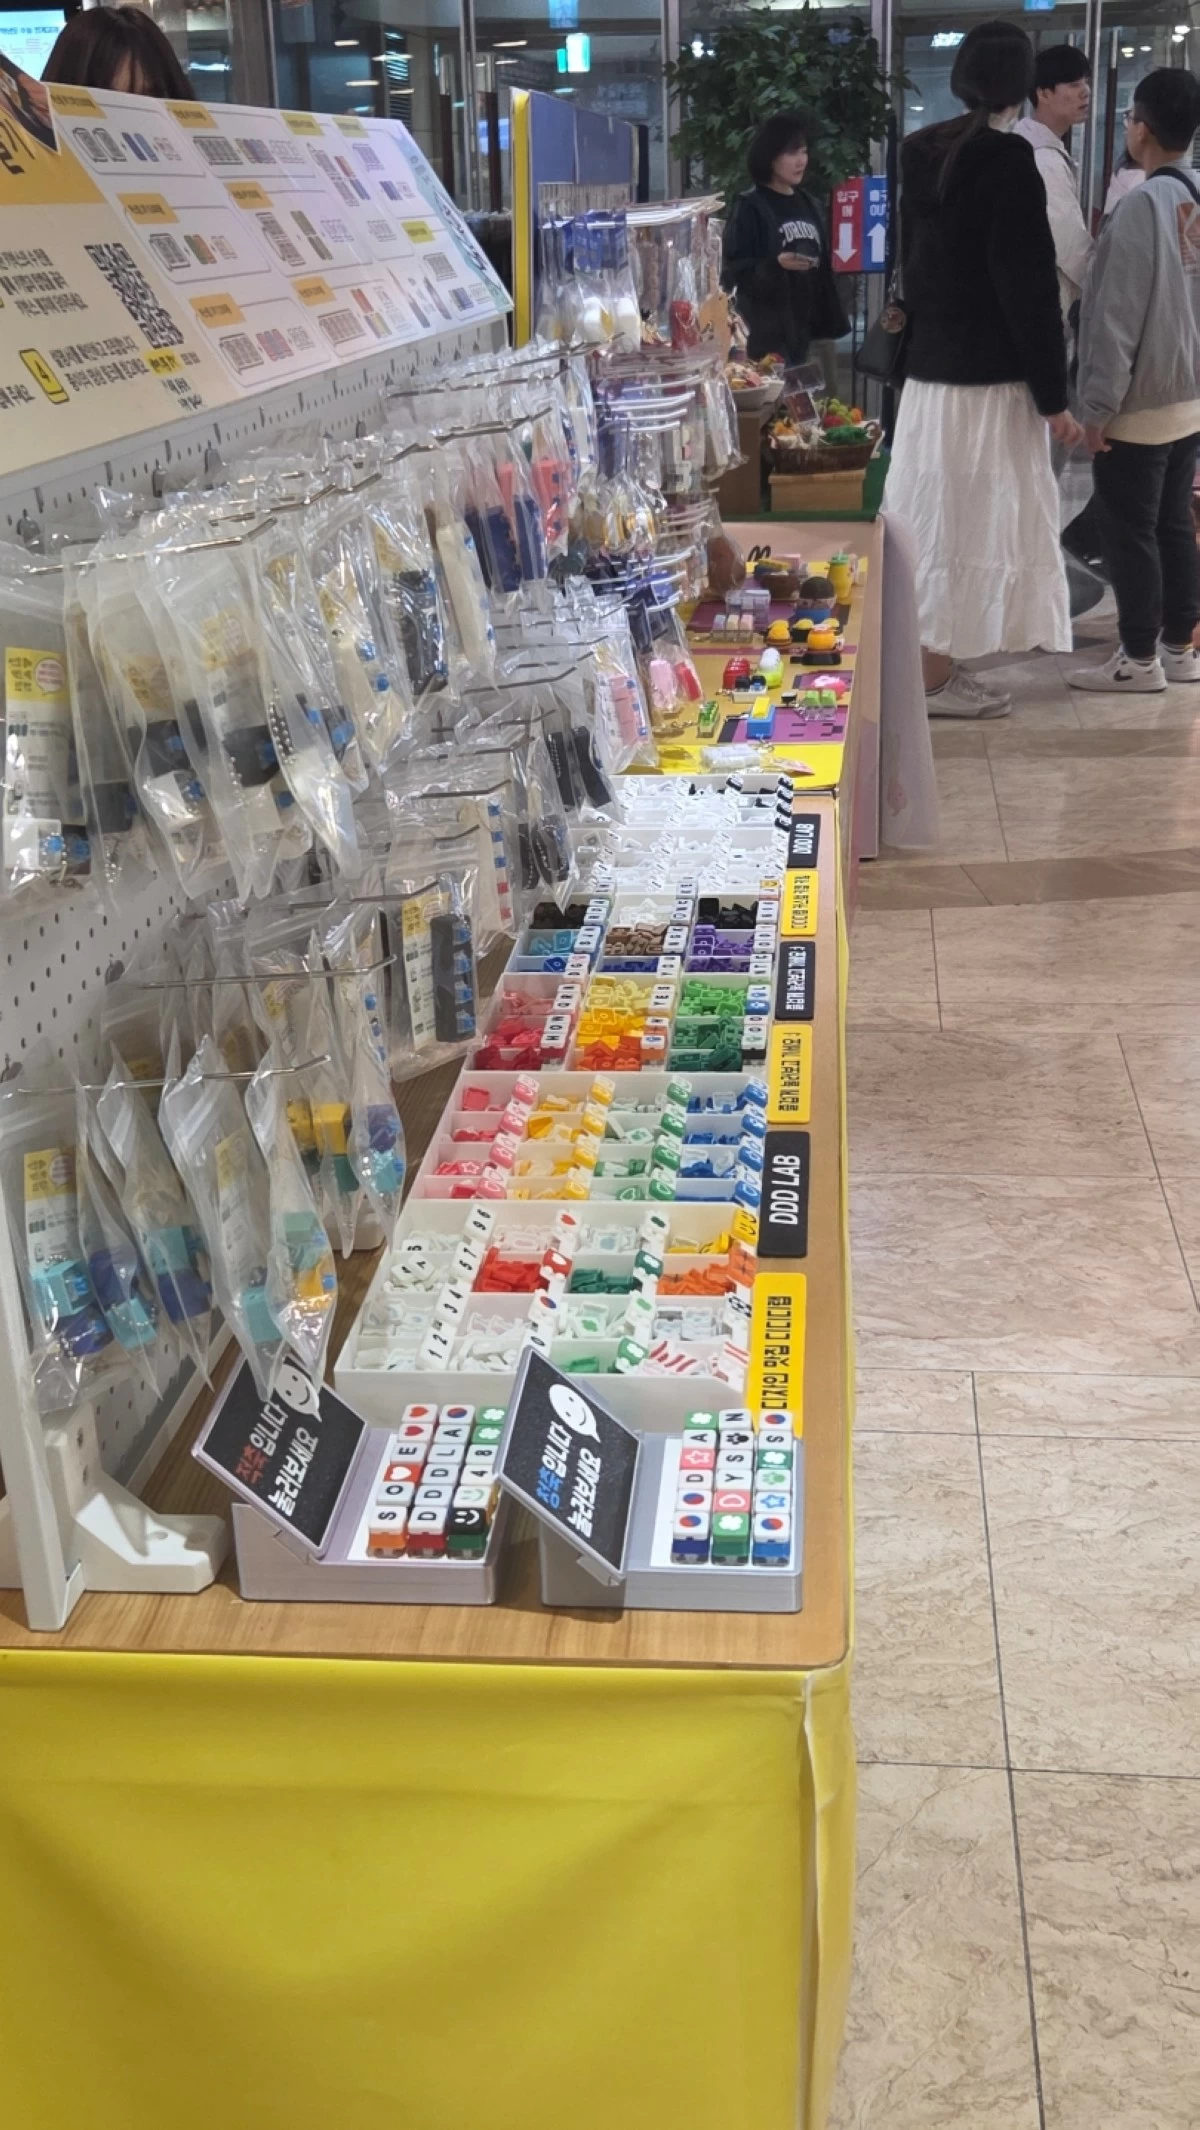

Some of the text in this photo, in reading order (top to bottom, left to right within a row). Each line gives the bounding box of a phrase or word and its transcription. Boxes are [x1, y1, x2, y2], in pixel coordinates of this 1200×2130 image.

[842, 205, 853, 217] IN
[795, 823, 815, 838] LAB
[769, 1154, 801, 1225] DDD LAB
[761, 1295, 792, 1410] 디자인 맛집 디디디랩
[235, 1400, 288, 1484] 적축입니다
[267, 1427, 319, 1517] 눌러보세요
[536, 1420, 573, 1509] 청축입니다
[567, 1447, 601, 1539] 눌러보세요
